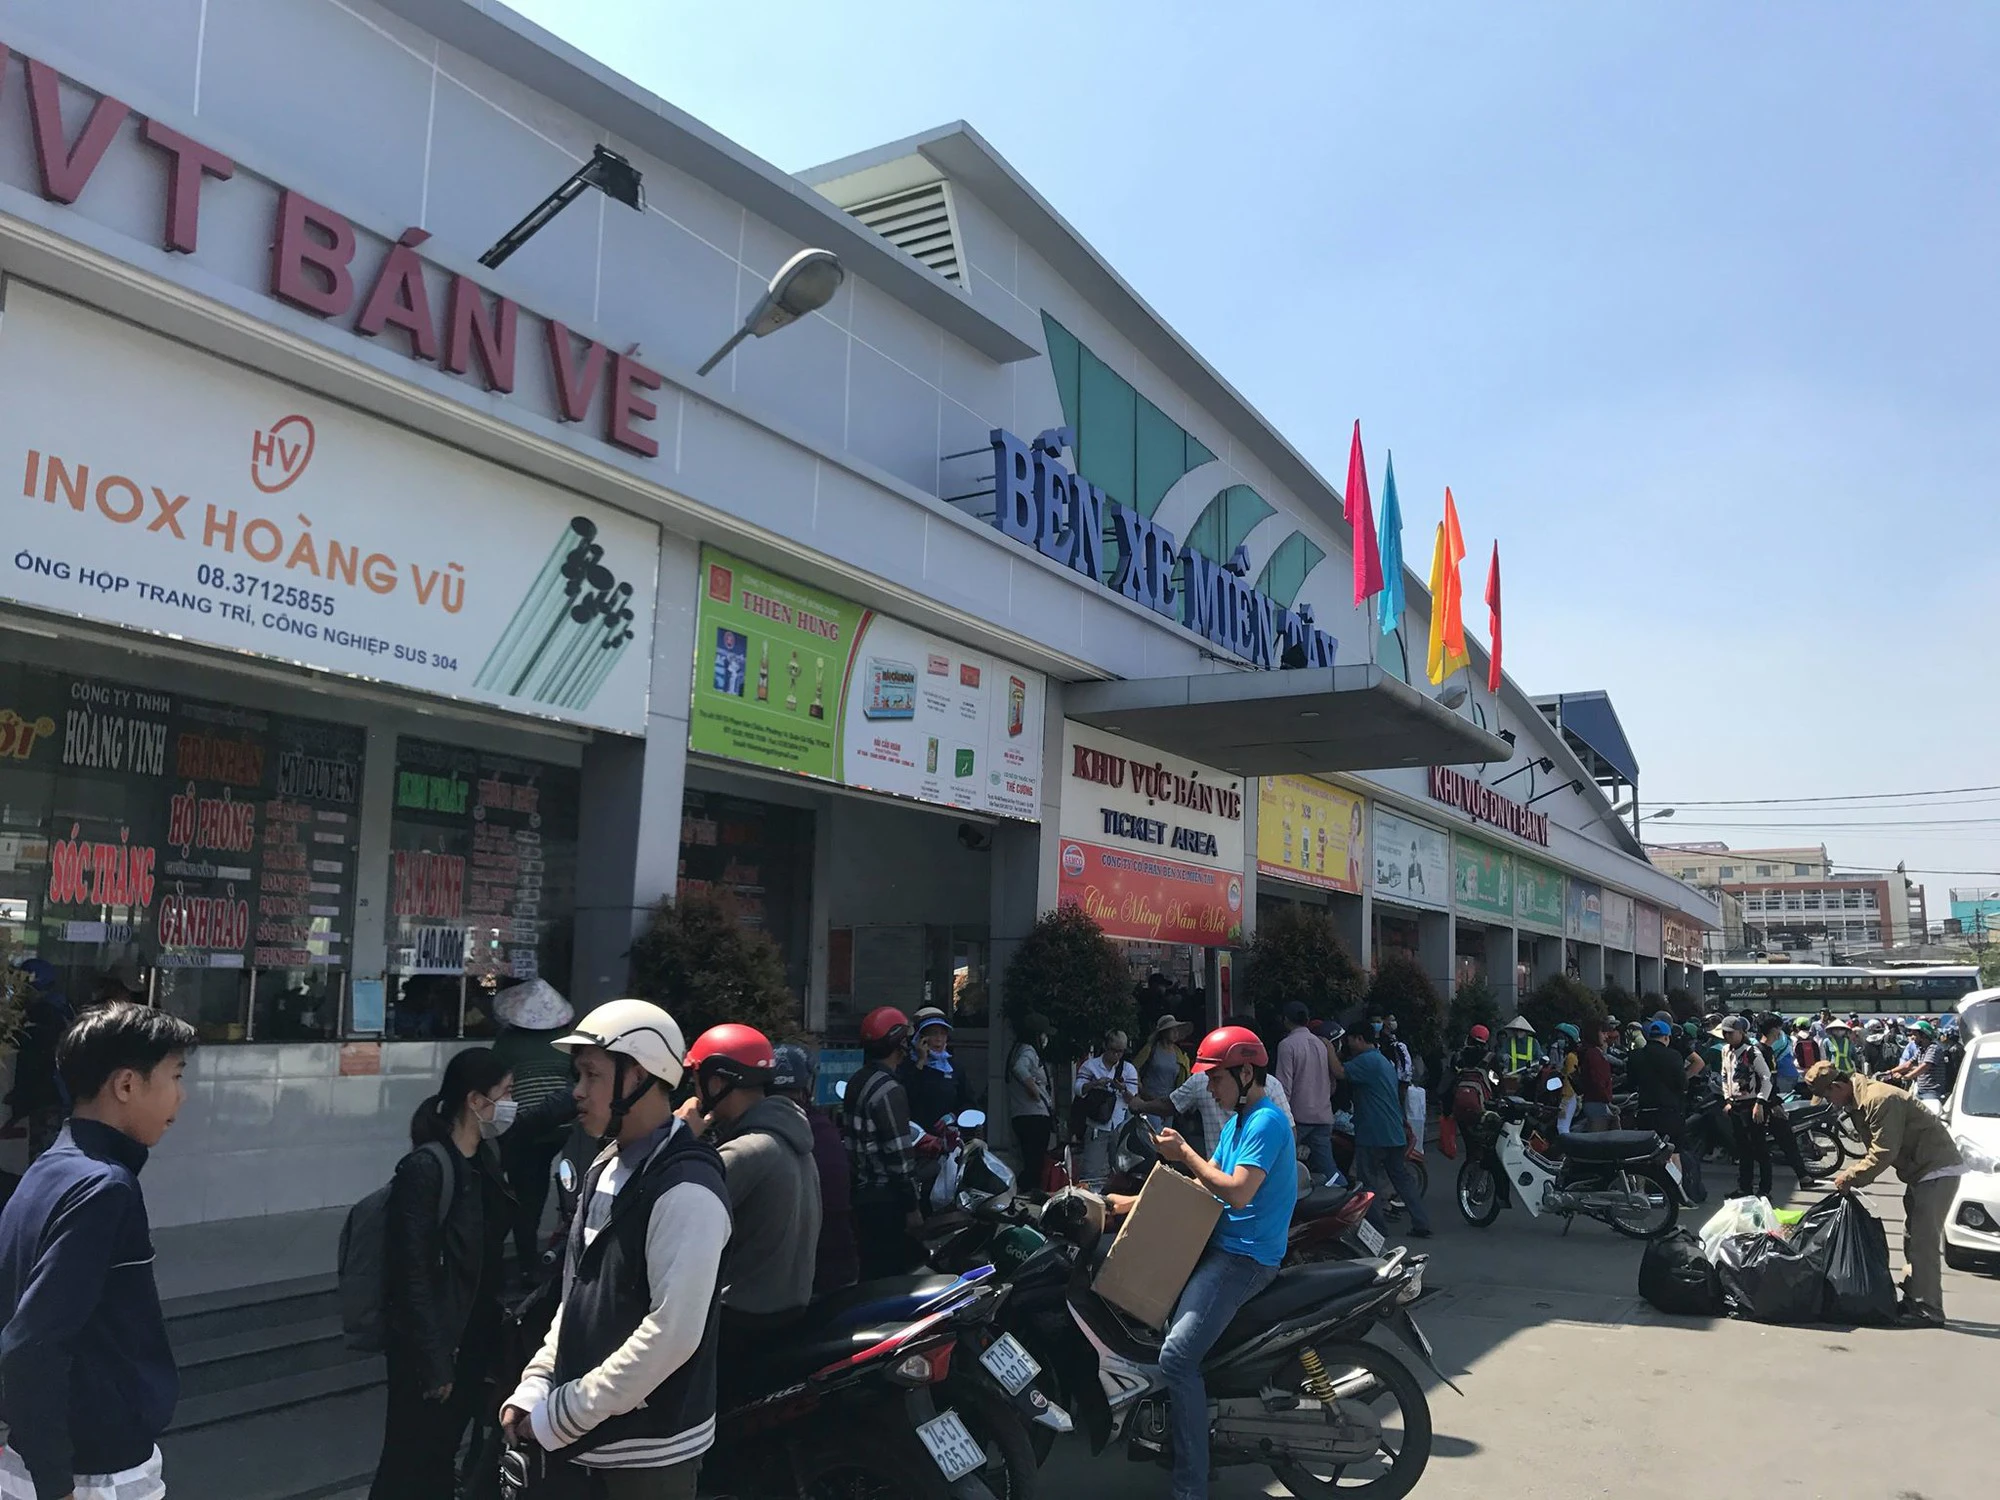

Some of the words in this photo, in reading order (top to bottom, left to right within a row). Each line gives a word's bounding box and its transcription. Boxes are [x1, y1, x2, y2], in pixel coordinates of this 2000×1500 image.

[0, 43, 233, 254] VT
[271, 188, 517, 394] BÁN
[545, 318, 661, 458] VÉ
[23, 450, 190, 540] INOX
[202, 503, 398, 595] HOÀNG
[411, 561, 466, 614] VŨ
[990, 427, 1106, 582] BẾN
[1108, 503, 1178, 622] XE
[197, 563, 335, 616] 08.37125855
[136, 581, 212, 614] TRANG
[219, 602, 256, 627] TRÍ,
[262, 611, 318, 640] CÔNG
[323, 627, 390, 657] NGHIỆP
[394, 644, 427, 665] SUS
[431, 651, 459, 672] 304
[113, 688, 130, 707] TY
[135, 692, 171, 713] TNHH
[63, 702, 124, 770] HOÀNG
[127, 718, 168, 776] VINH
[1072, 744, 1126, 789] KHU
[1130, 763, 1172, 806] VỰC
[1173, 770, 1213, 815] BÁN
[1216, 782, 1242, 821] VÉ
[1429, 765, 1461, 807] KHU
[1100, 808, 1168, 845] TICKET
[1171, 826, 1219, 857] AREA
[50, 822, 92, 904] SÓC
[91, 826, 156, 908] TRĂNG
[1084, 884, 1117, 920] Chúc
[1120, 891, 1163, 938] Mừng
[1165, 897, 1197, 931] Năm
[1005, 1244, 1028, 1260] Grab
[937, 1438, 980, 1475] 265.17
